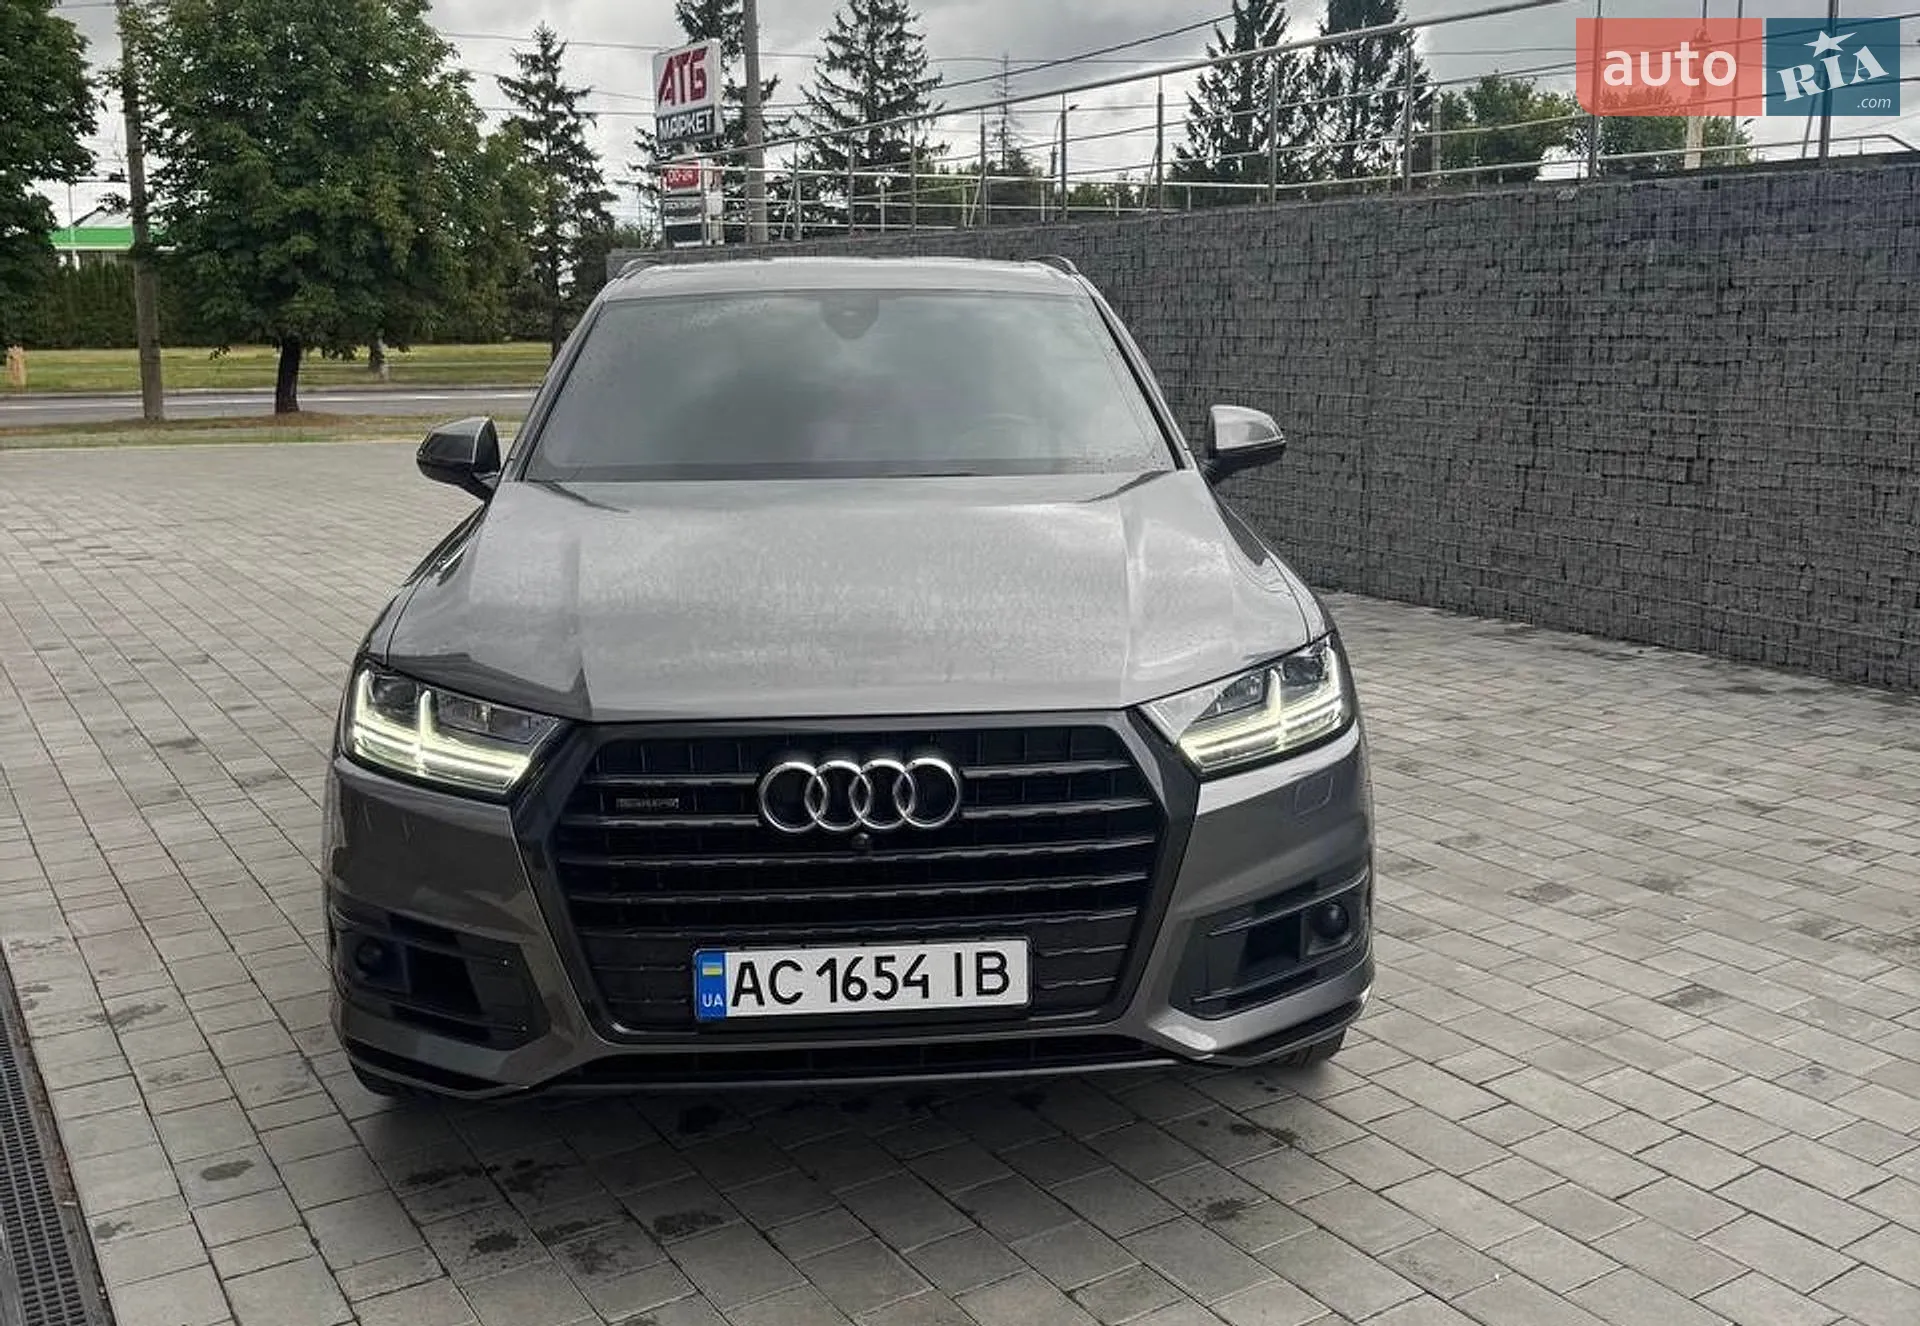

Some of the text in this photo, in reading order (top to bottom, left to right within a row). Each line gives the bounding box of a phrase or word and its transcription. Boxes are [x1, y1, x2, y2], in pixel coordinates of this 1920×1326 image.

[658, 46, 708, 106] АТБ
[658, 109, 713, 142] МАРКЕТ
[702, 993, 723, 1008] UA
[731, 950, 1010, 1007] AC 1654 IB
